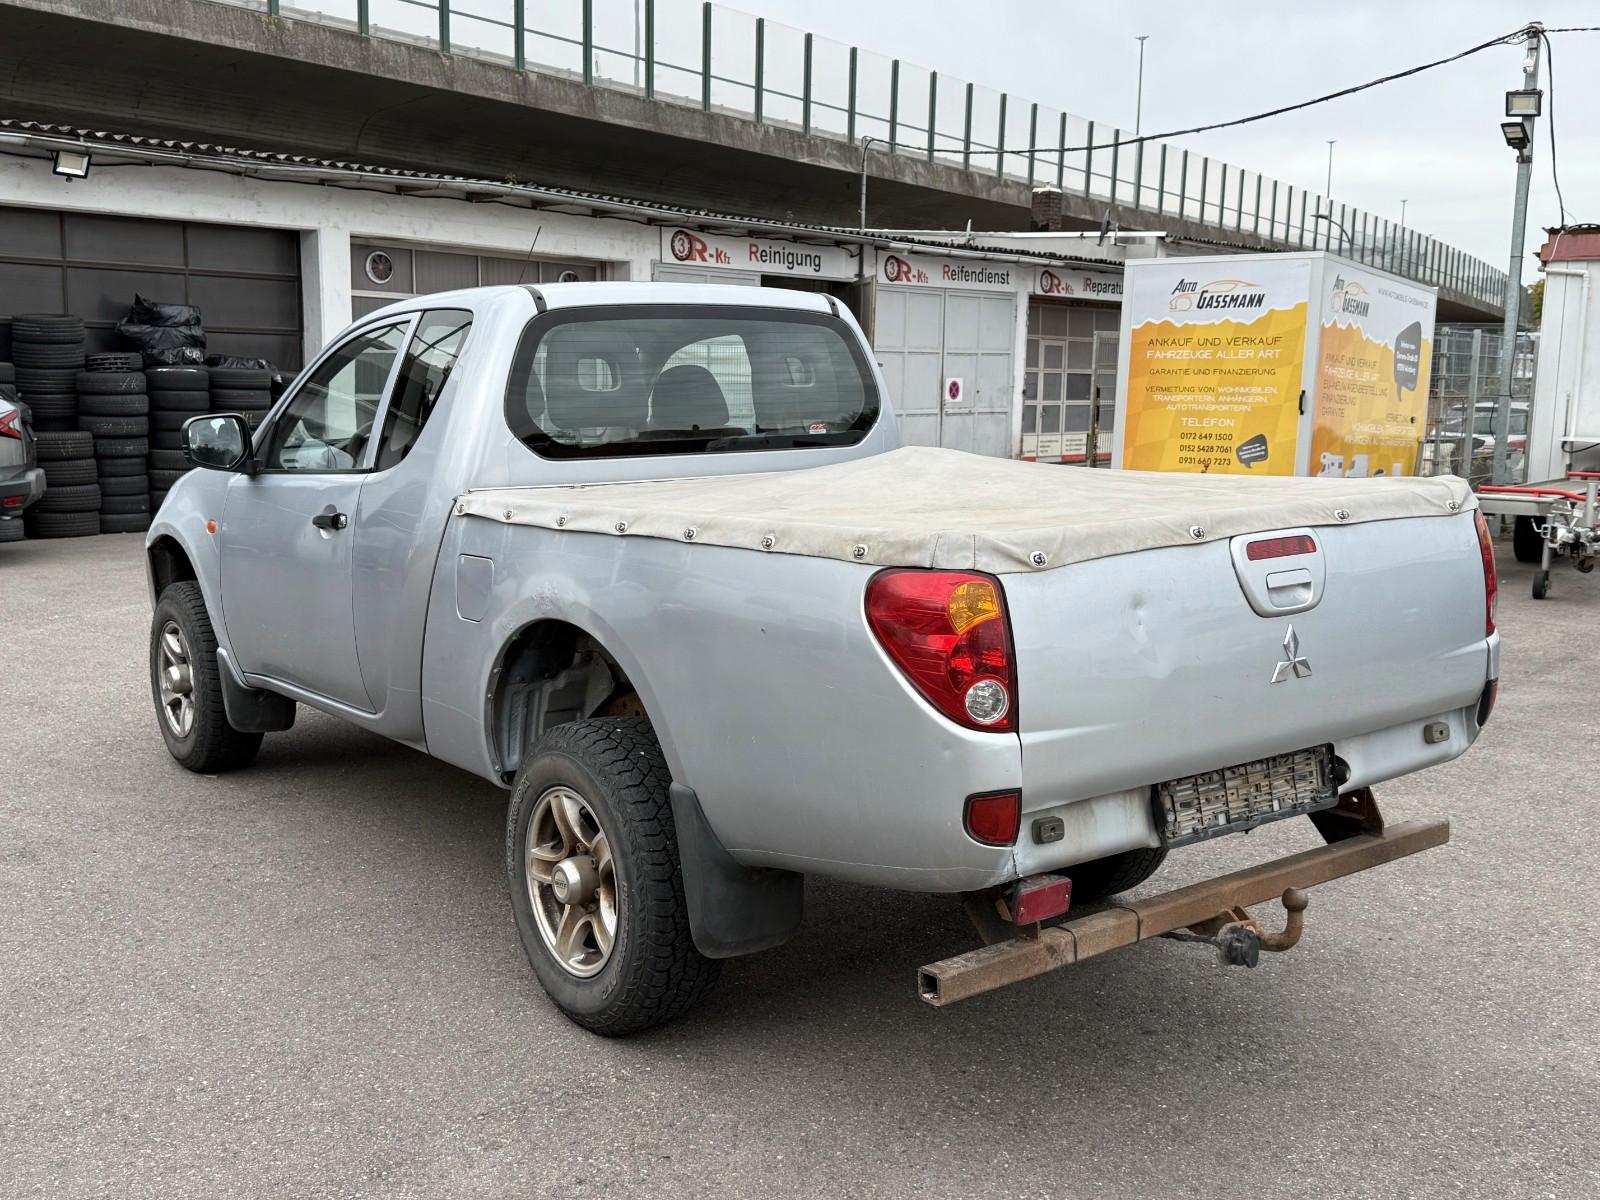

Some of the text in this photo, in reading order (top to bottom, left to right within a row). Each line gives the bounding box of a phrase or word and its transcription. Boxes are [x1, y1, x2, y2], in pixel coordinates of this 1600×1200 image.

[749, 243, 822, 273] Reinigung
[942, 264, 1010, 285] Reifendienst
[1196, 290, 1265, 309] GASSMANN
[1148, 336, 1283, 347] ANKAUF UND VERKAUF
[1146, 349, 1281, 360] FAHRZEUGE ALLER ART
[1149, 368, 1276, 376] GARANTIE UND FINANZIERUNG
[1182, 417, 1234, 428] TELEFON
[1180, 432, 1233, 441] 0172 649 1500
[1180, 444, 1196, 452] 0152
[1197, 445, 1214, 453] 5428
[1179, 456, 1196, 464] 0931
[1213, 458, 1231, 466] 7273
